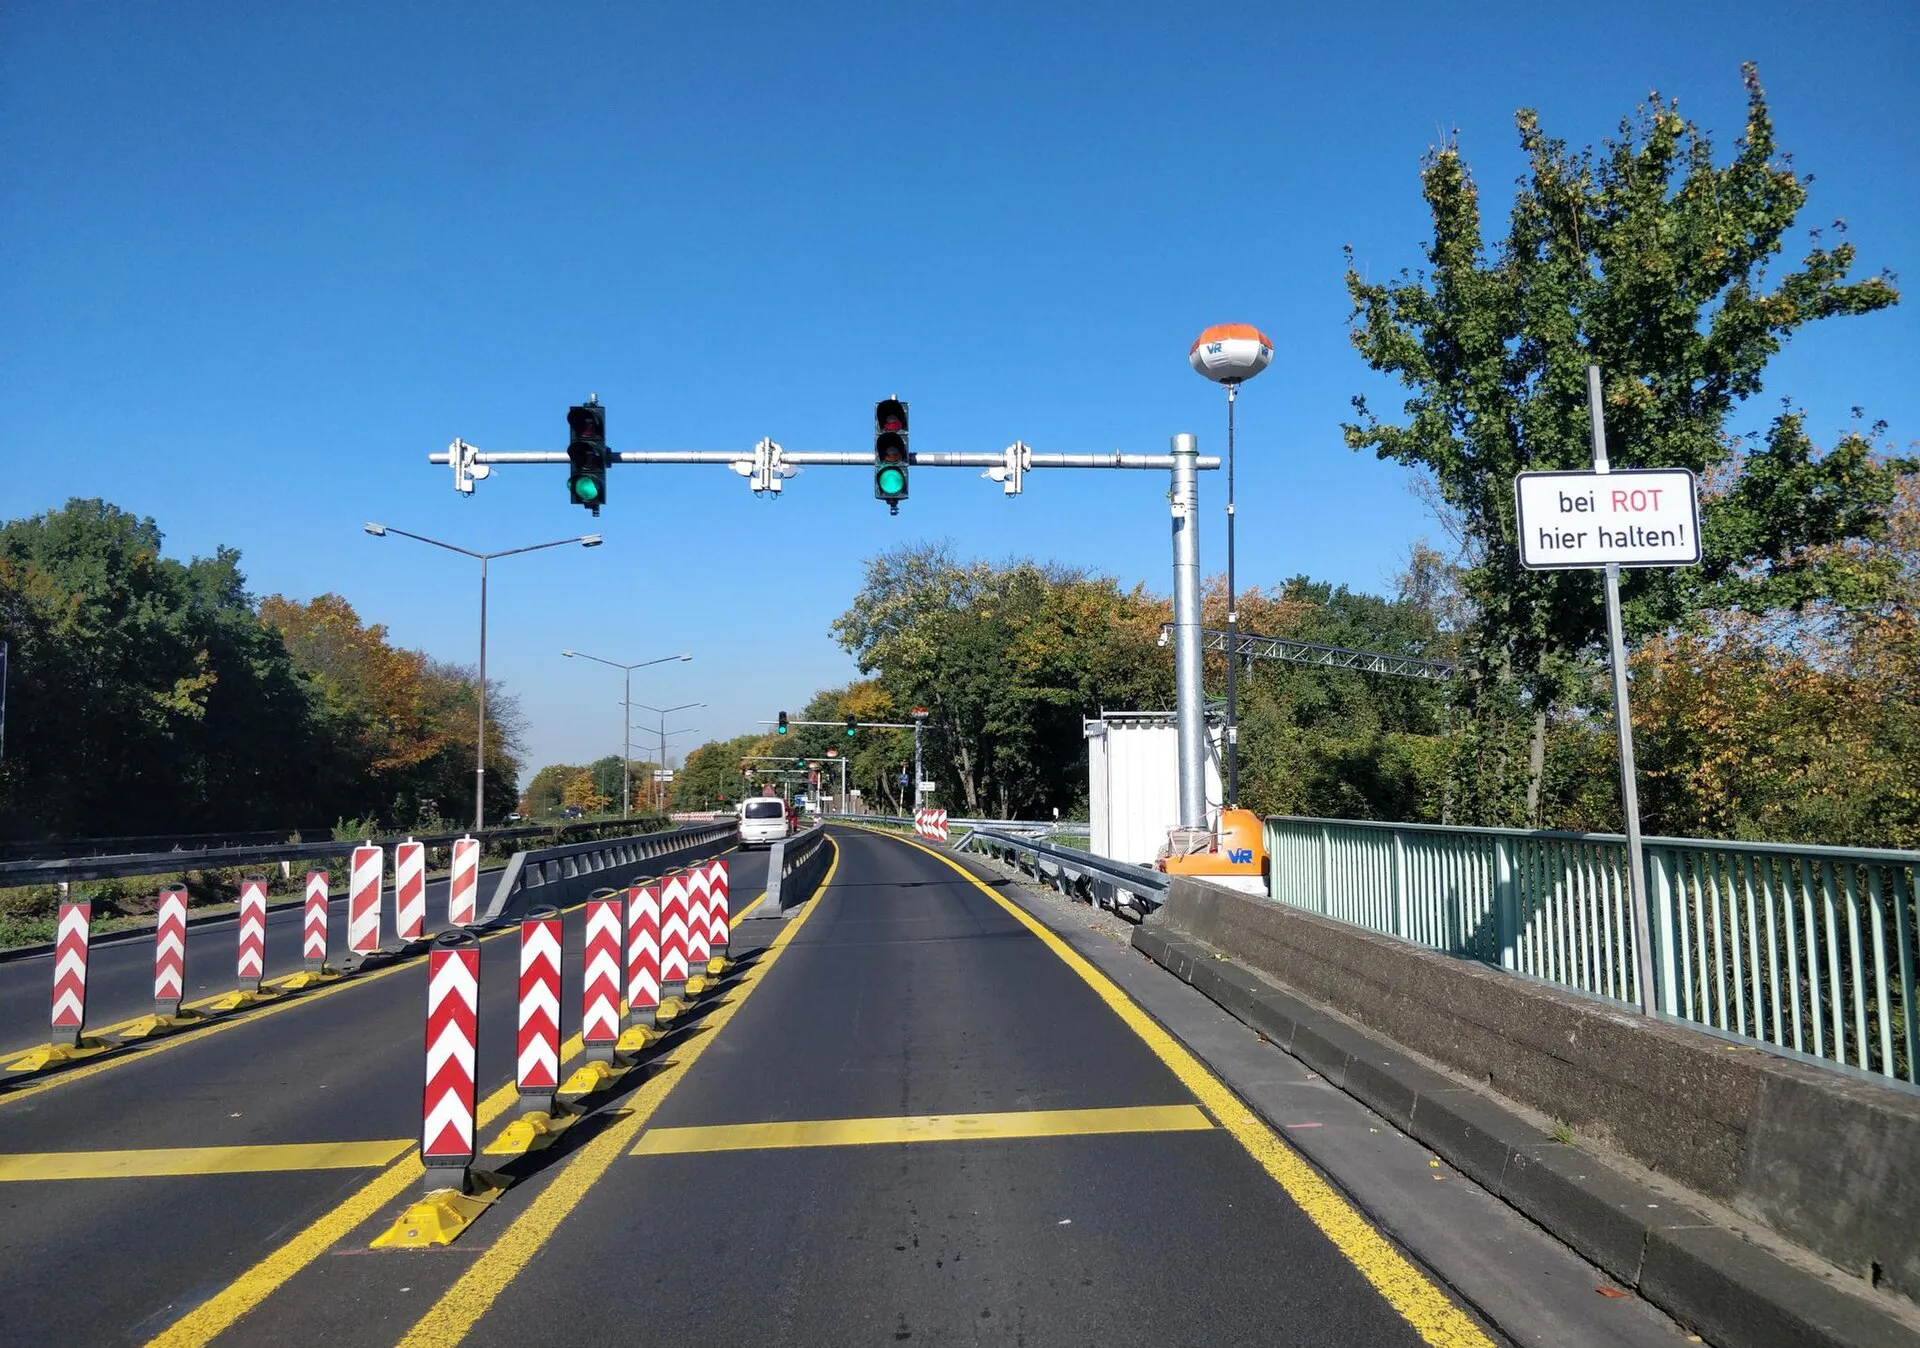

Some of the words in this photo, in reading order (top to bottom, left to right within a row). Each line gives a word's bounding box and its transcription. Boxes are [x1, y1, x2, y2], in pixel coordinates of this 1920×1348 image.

[1559, 490, 1595, 513] bei
[1611, 489, 1663, 512] ROT
[1539, 527, 1588, 550] hier
[1598, 524, 1685, 548] halten!
